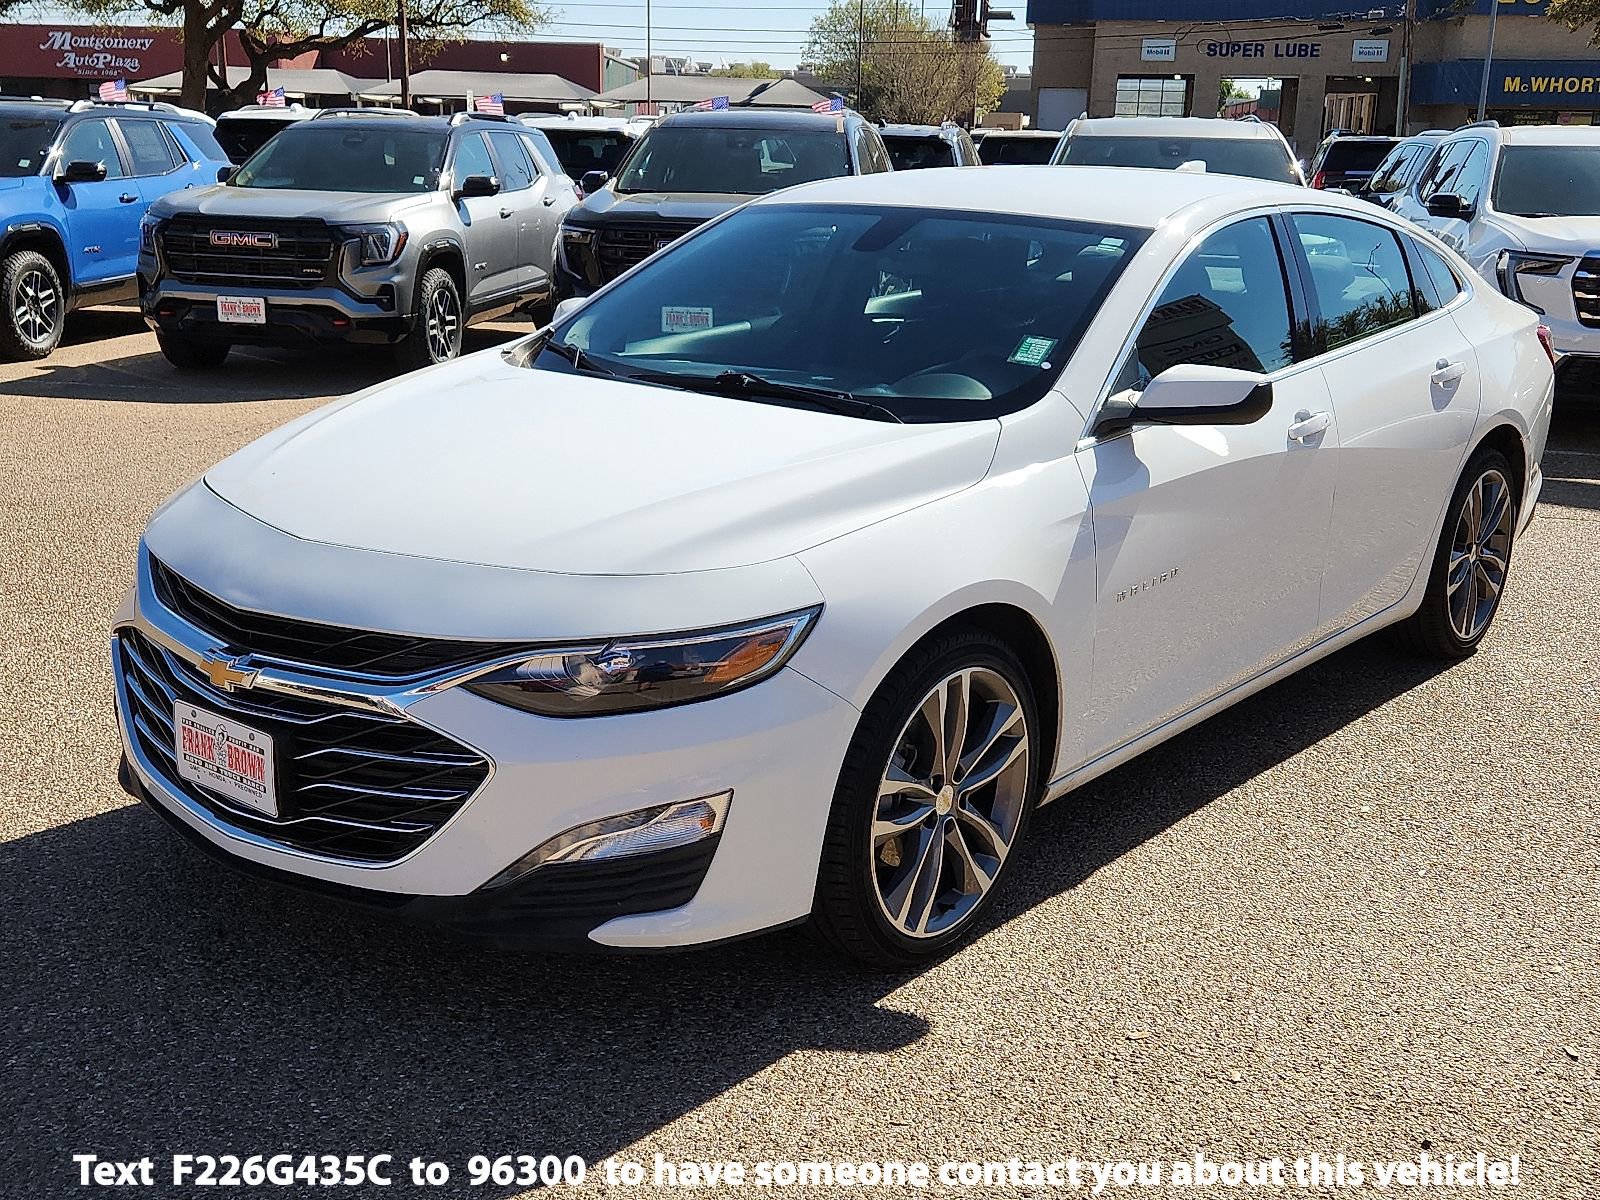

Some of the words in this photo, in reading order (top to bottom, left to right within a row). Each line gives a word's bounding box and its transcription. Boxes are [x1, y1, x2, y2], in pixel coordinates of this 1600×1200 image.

[39, 31, 154, 51] Montgomery
[1206, 43, 1265, 57] SUPER
[1274, 43, 1322, 58] LUBE
[211, 232, 272, 247] GMC
[1116, 568, 1179, 603] MALIBU
[181, 725, 216, 764] FRANK
[226, 743, 265, 784] BROWN
[185, 753, 202, 767] AUTO
[204, 761, 217, 772] AND
[219, 766, 241, 782] TRUCK
